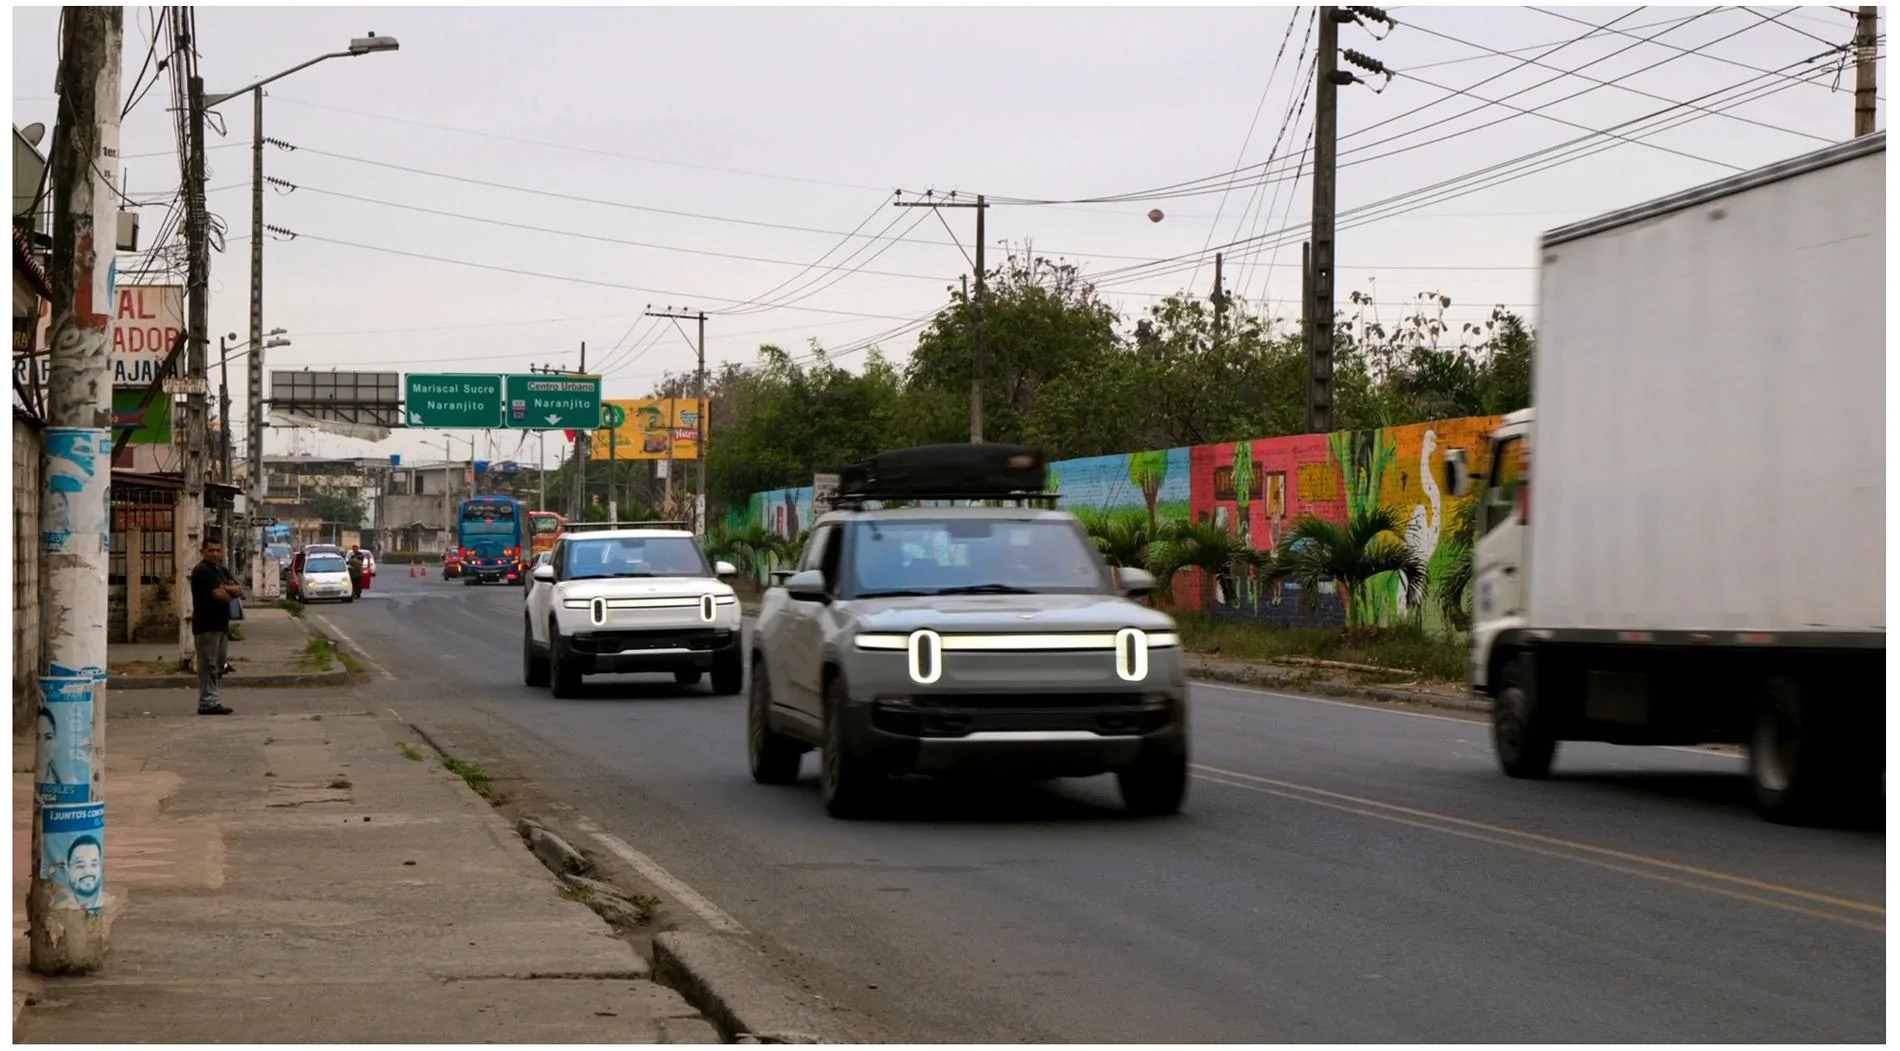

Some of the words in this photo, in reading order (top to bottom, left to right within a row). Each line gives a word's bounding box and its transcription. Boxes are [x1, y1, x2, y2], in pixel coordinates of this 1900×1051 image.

[412, 383, 458, 393] Mariscal
[463, 383, 495, 394] Sucre
[528, 381, 559, 391] Centro
[561, 382, 594, 392] Urbano
[427, 401, 484, 412] Naranjito
[534, 399, 591, 410] Naranjito
